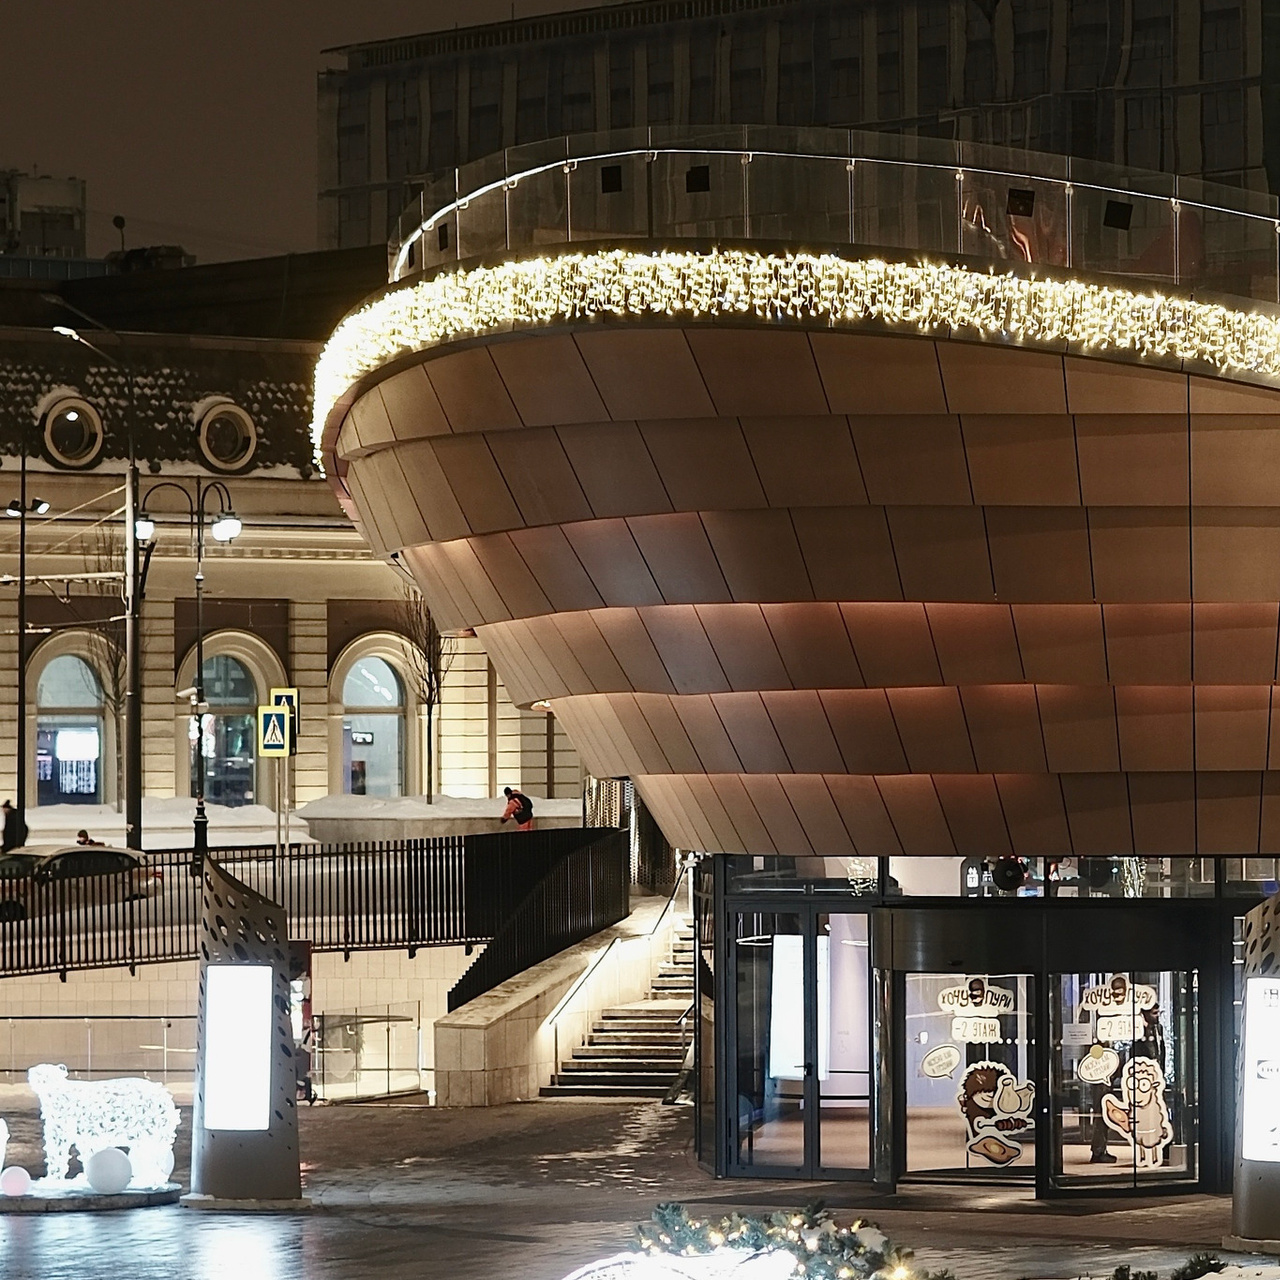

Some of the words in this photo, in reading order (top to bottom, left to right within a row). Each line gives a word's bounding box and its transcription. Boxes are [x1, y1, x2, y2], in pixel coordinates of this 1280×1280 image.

[941, 989, 969, 1008] ХОЧУ
[985, 989, 1012, 1008] ПУРИ
[1084, 988, 1112, 1007] ХОЧУ
[955, 1021, 968, 1038] -2
[972, 1021, 997, 1038] ЭТАЖ
[1101, 1020, 1114, 1038] -2
